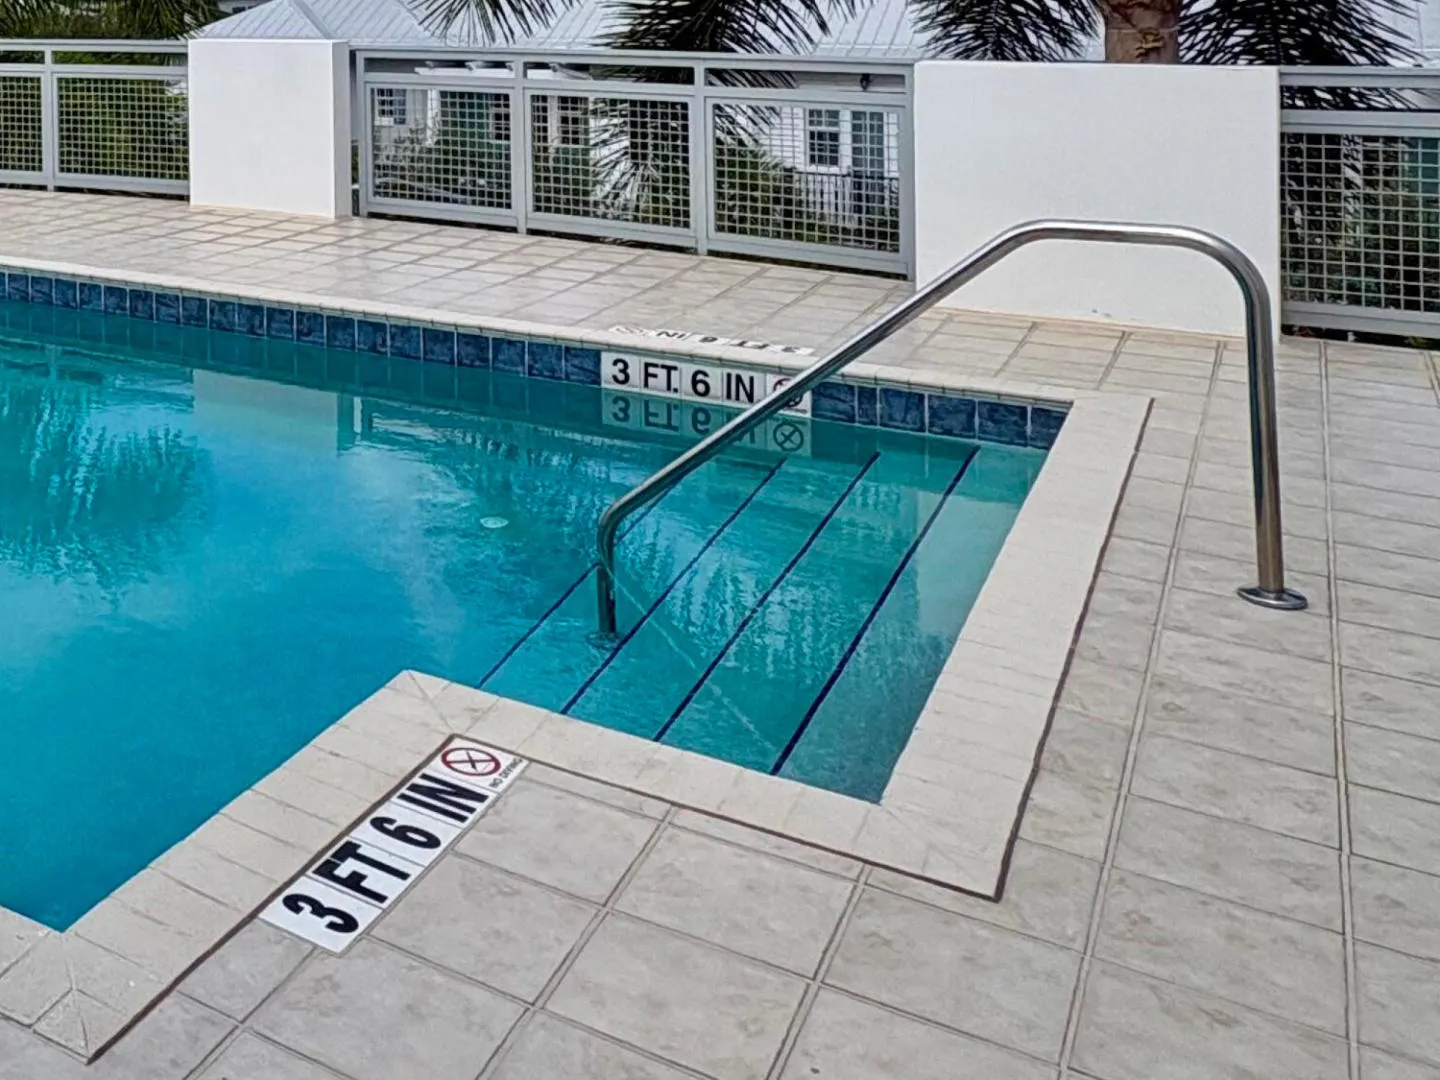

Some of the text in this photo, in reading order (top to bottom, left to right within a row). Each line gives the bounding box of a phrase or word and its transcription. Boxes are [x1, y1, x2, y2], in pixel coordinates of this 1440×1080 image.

[612, 358, 754, 404] 3 FT. 6 IN
[282, 773, 489, 934] 3 FT 6 IN
